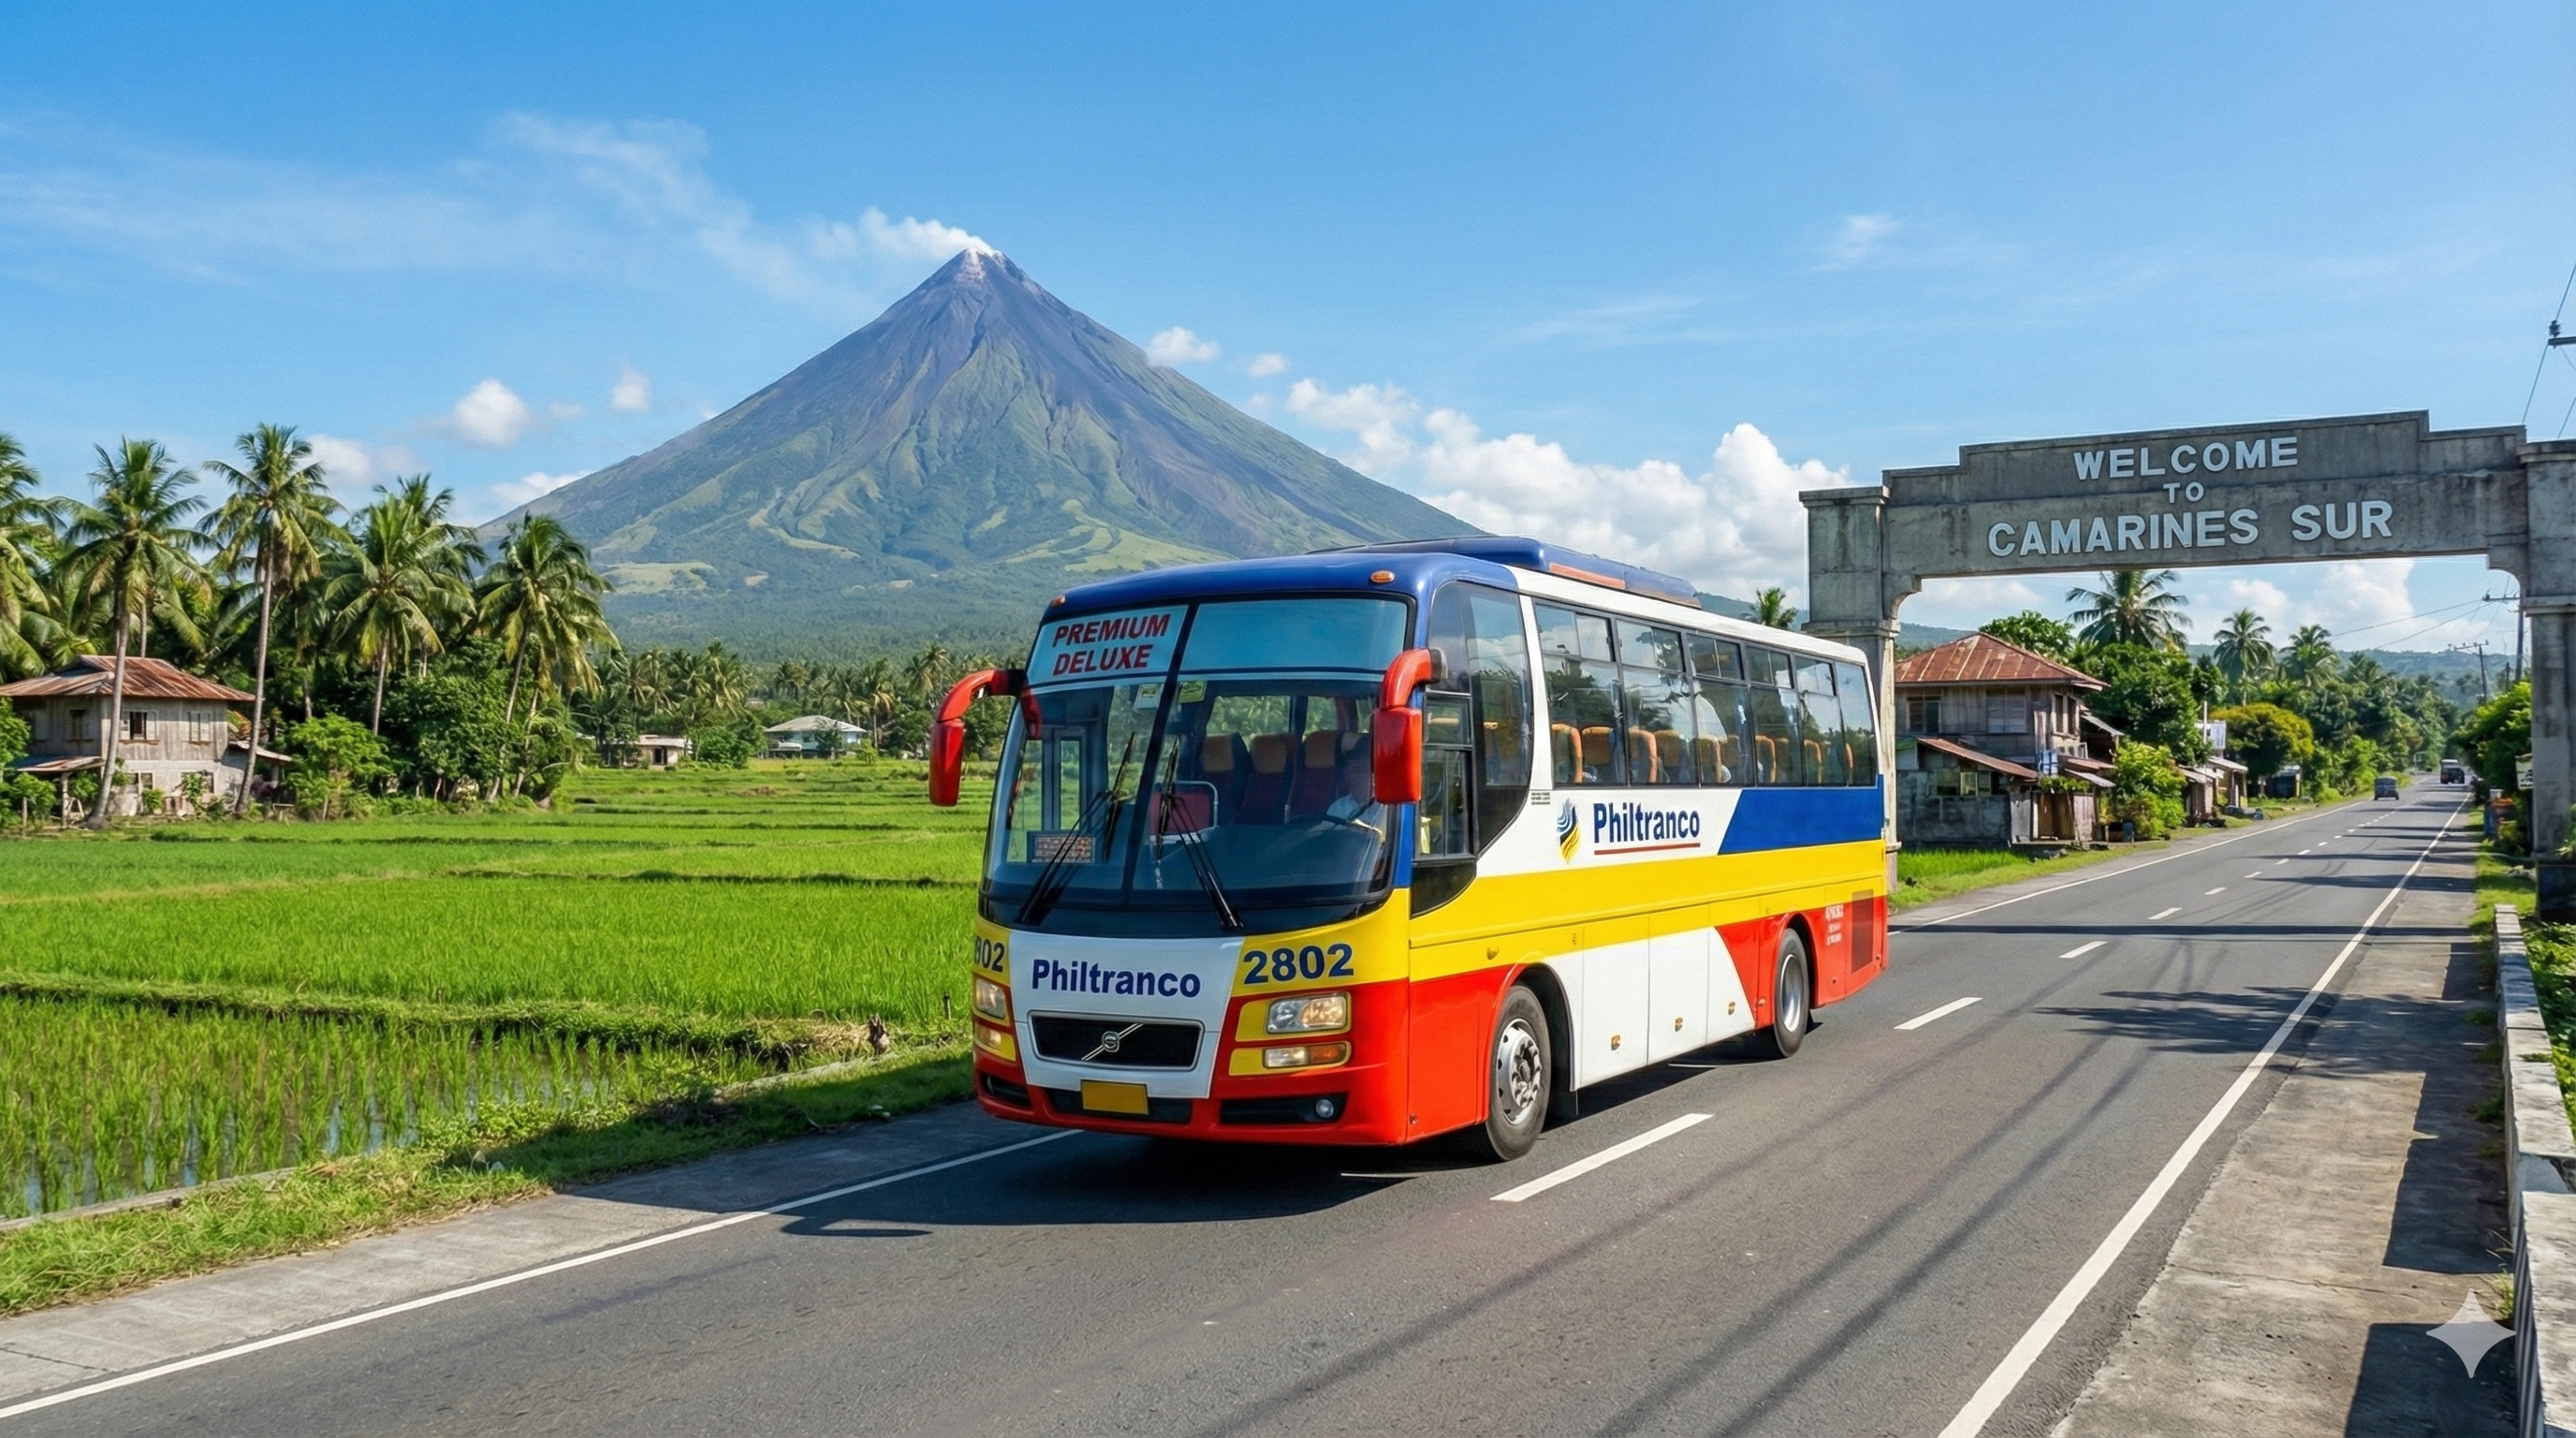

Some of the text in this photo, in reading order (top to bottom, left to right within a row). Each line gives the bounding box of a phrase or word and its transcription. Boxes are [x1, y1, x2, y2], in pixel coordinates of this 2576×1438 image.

[2073, 436, 2298, 480] WELCOME
[2162, 481, 2204, 504] TO
[1987, 500, 2393, 557] CAMARINES SUR
[1051, 613, 1171, 648] PREMIUM
[1052, 644, 1153, 676] DELUXE
[1593, 801, 1701, 844] Philtranco
[1031, 958, 1202, 999] Philtranco
[1243, 943, 1354, 985] 2802
